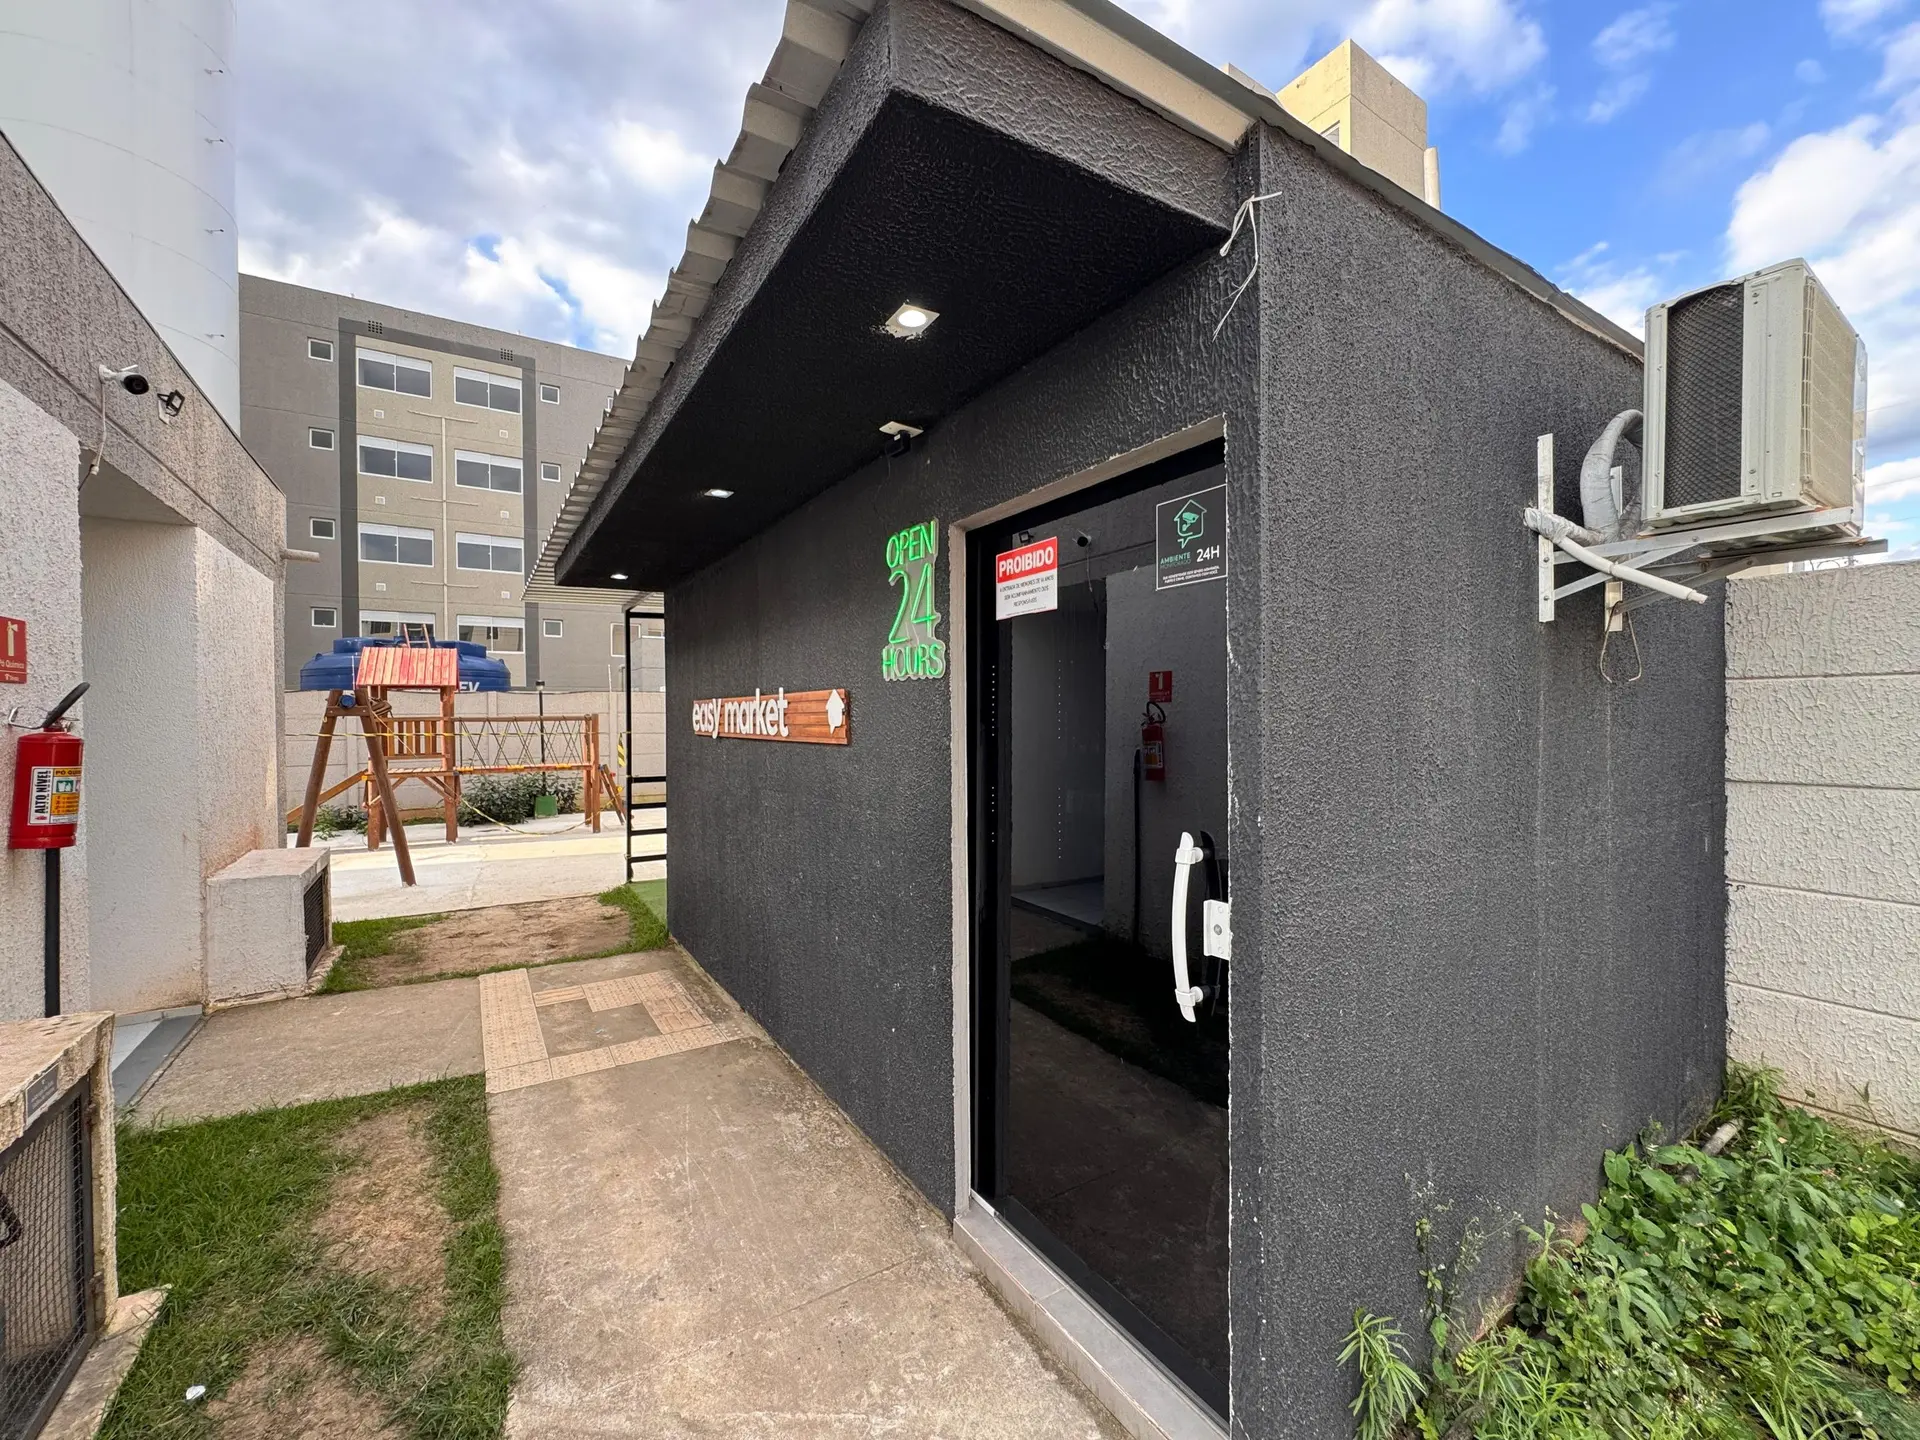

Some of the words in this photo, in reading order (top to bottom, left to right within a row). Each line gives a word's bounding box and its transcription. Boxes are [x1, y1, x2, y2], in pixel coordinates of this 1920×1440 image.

[886, 520, 936, 568] OPEN
[1160, 552, 1190, 565] AMBIENTE
[1196, 545, 1219, 562] 24H
[999, 546, 1054, 578] PROIBIDO
[888, 563, 937, 642] 24
[882, 643, 943, 679] HOURS
[692, 698, 722, 739] easy
[724, 687, 789, 737] market
[35, 771, 48, 792] NÍVEL
[35, 795, 46, 813] ALTO
